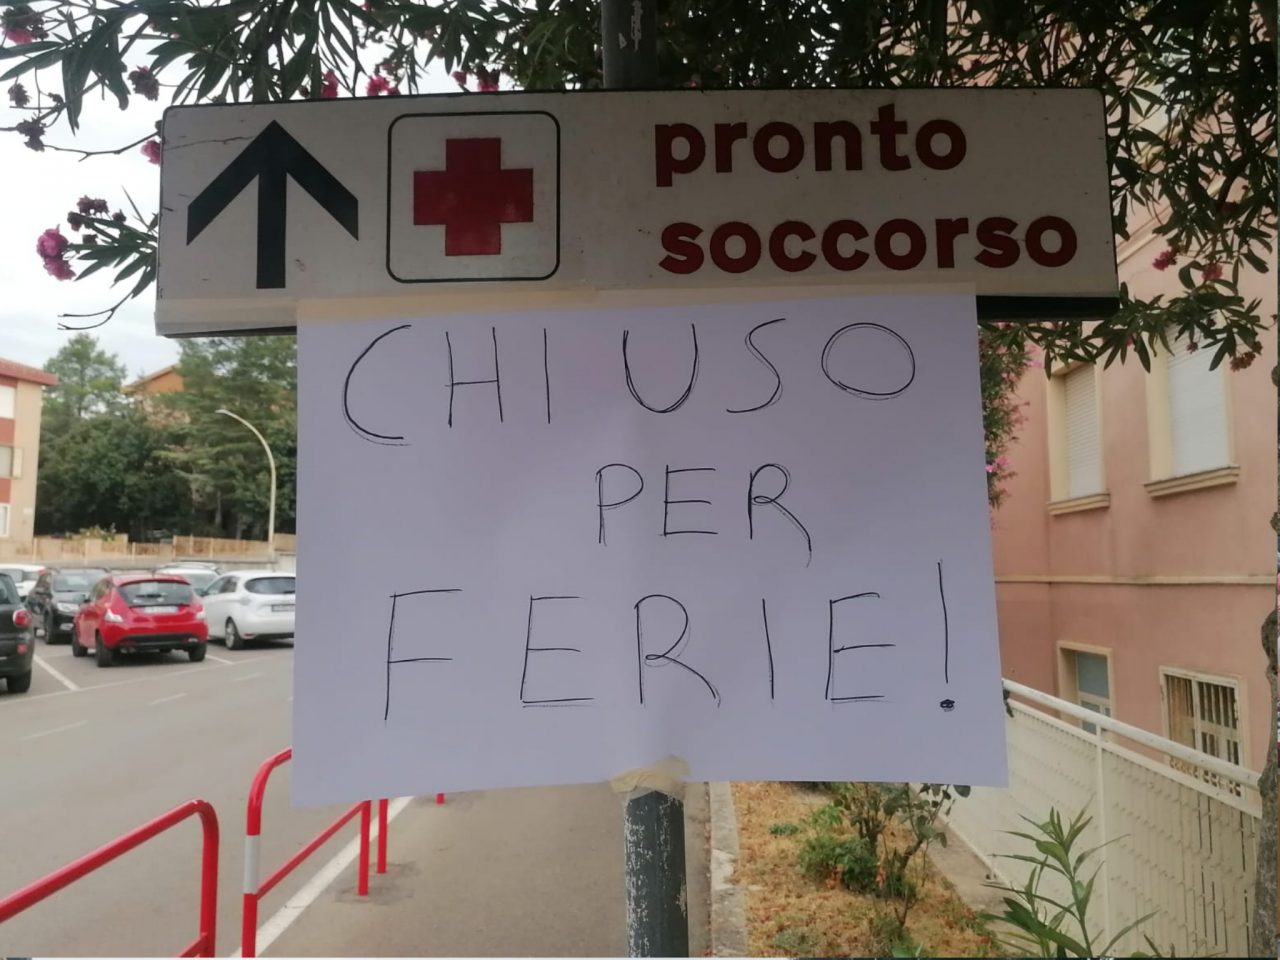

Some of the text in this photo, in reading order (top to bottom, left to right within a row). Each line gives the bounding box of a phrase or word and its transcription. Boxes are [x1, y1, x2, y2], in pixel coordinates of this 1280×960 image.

[654, 103, 968, 188] pronto
[657, 212, 1080, 276] soccorso
[342, 317, 917, 447] CHIUSO
[594, 462, 813, 568] PER
[383, 561, 956, 722] FERIE!
